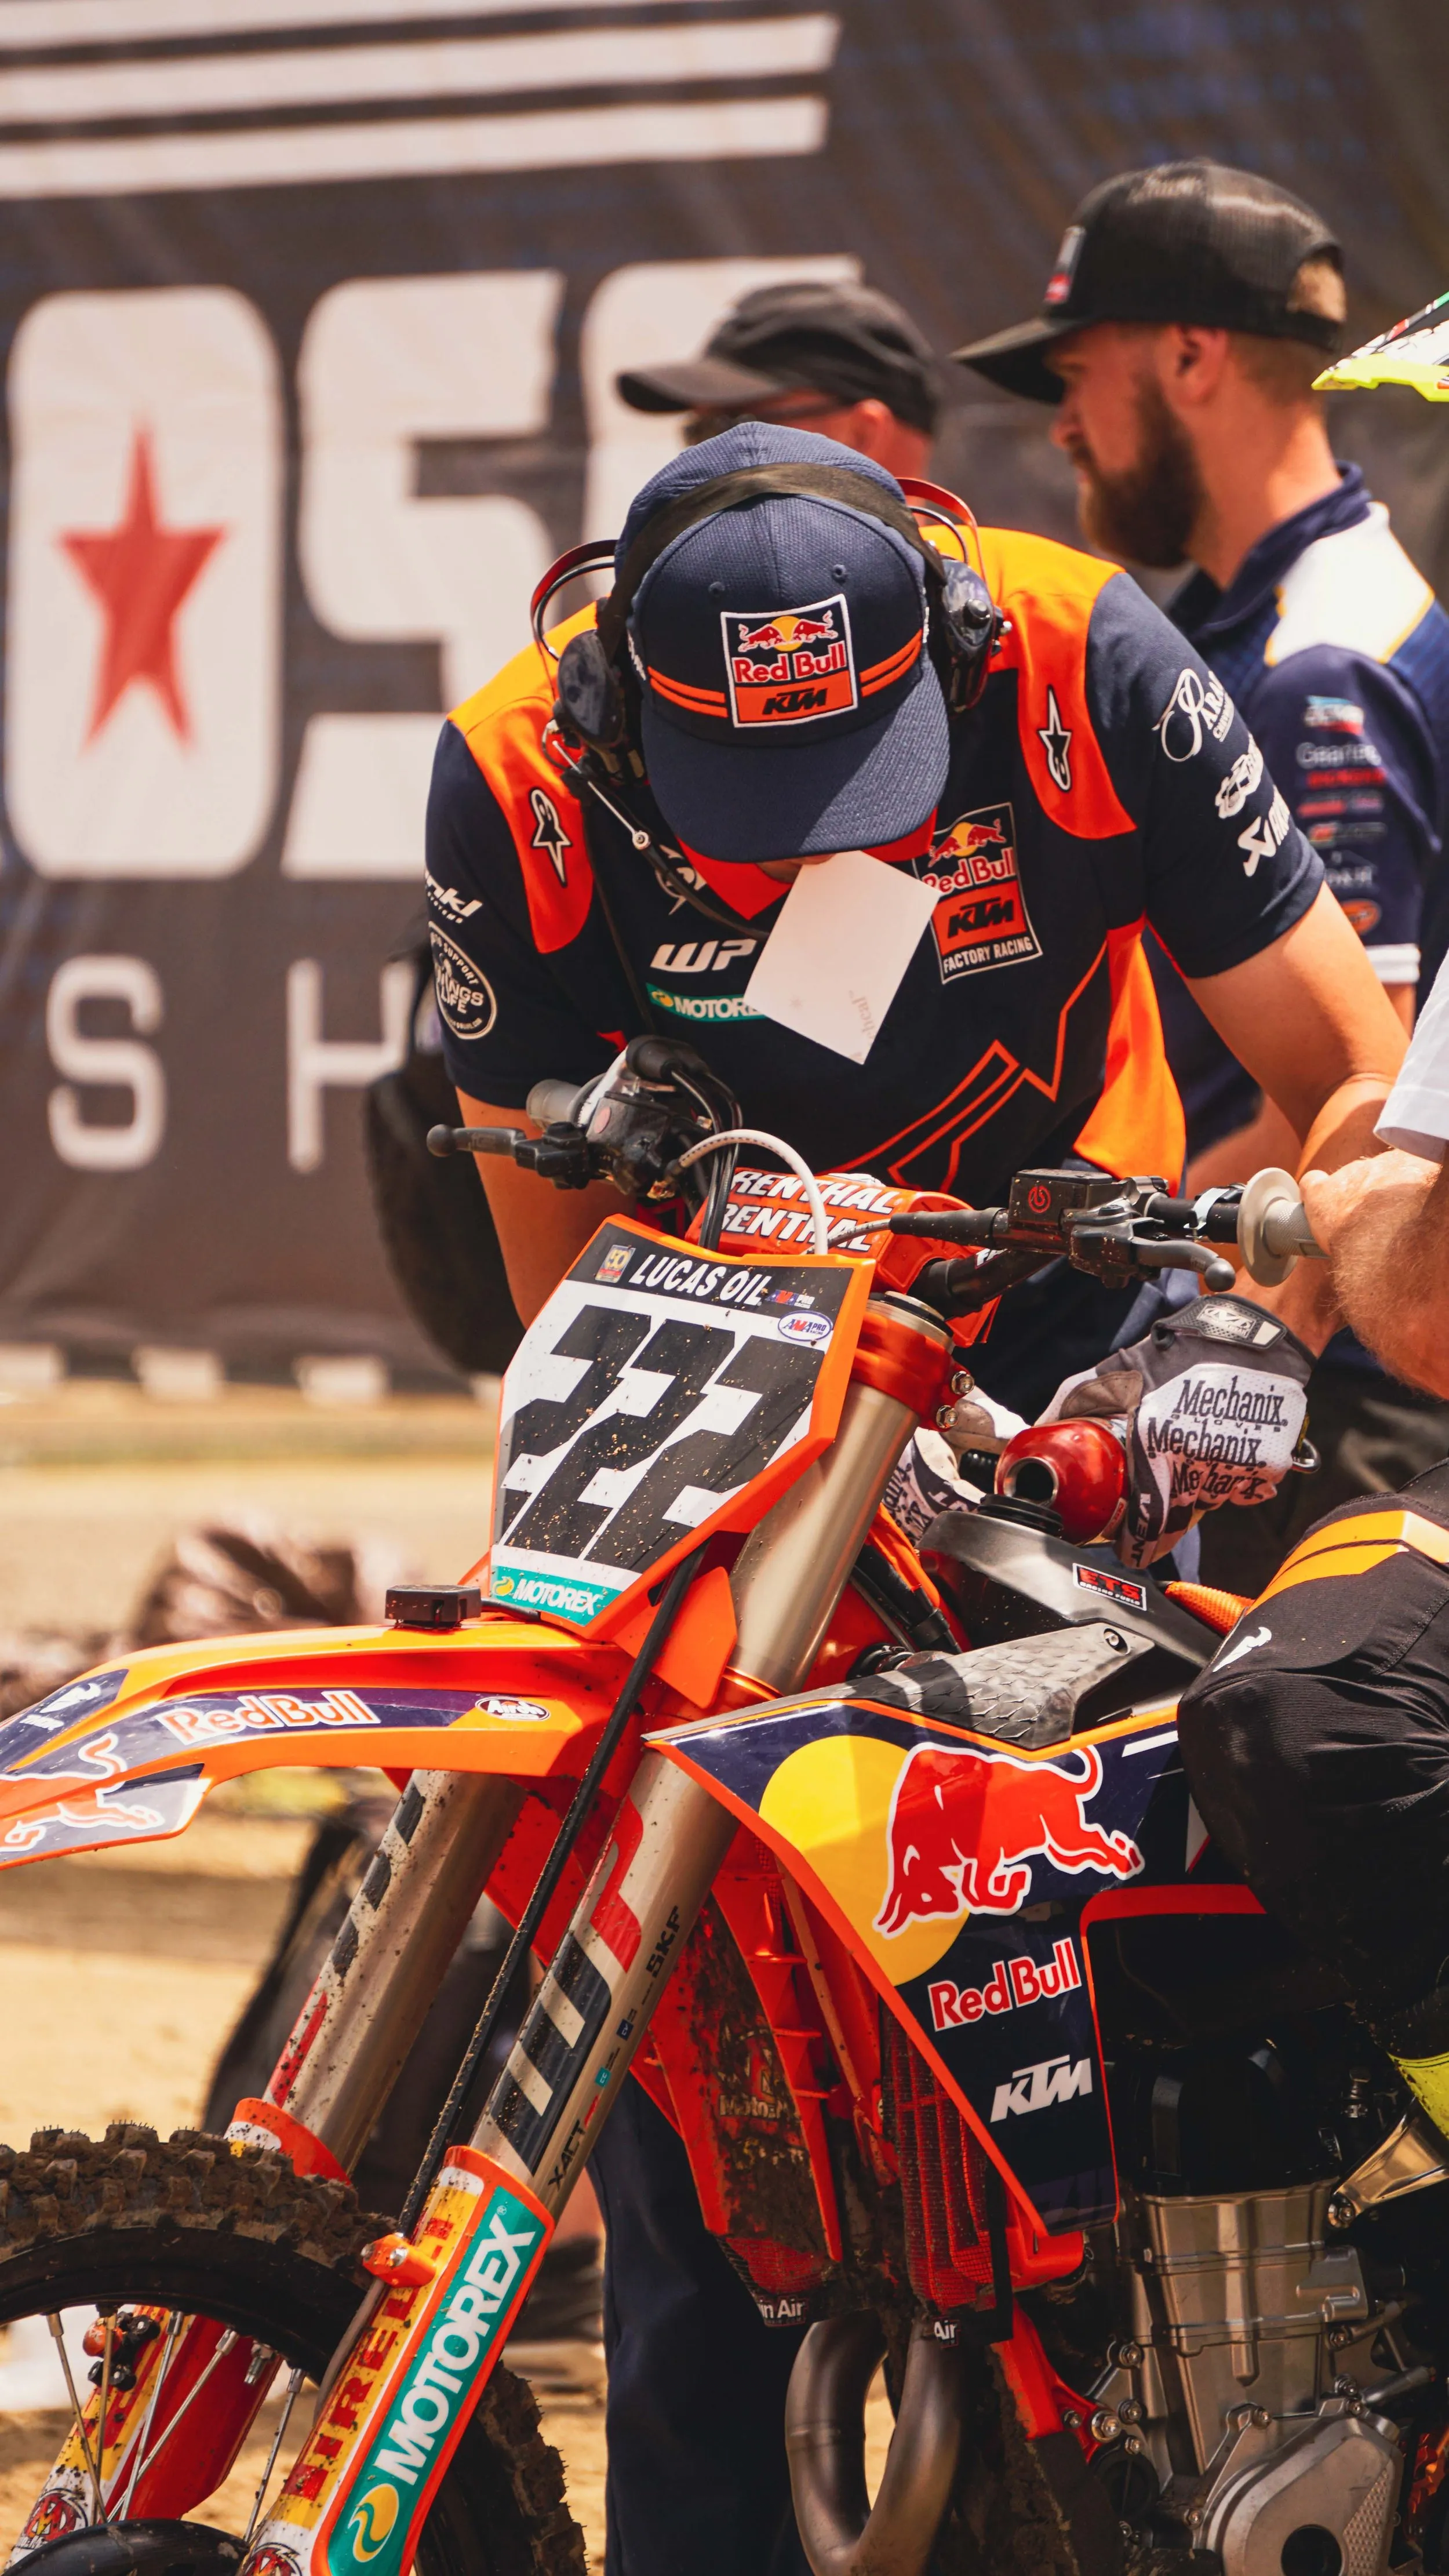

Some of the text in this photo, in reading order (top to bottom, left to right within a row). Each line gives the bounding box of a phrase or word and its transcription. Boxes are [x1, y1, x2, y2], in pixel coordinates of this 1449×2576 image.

[731, 640, 847, 683] Red Bull
[762, 687, 828, 715] KTM
[969, 846, 1016, 885] Bull
[947, 896, 1014, 938] KTM
[650, 938, 758, 973] WP
[943, 936, 1034, 974] FACTORY RACING
[628, 1254, 772, 1306] LUCAS OIL
[782, 1319, 827, 1333] AMA PRO
[500, 1304, 825, 1575] 222
[513, 1577, 602, 1617] MOTOREX
[1079, 1567, 1140, 1600] ETS
[155, 1689, 381, 1745] Red Bull
[646, 1905, 680, 1979] SKF
[927, 1937, 1082, 2032] Red Bull
[990, 2054, 1093, 2123] KTM
[777, 2298, 806, 2319] Air
[934, 2319, 958, 2340] Air
